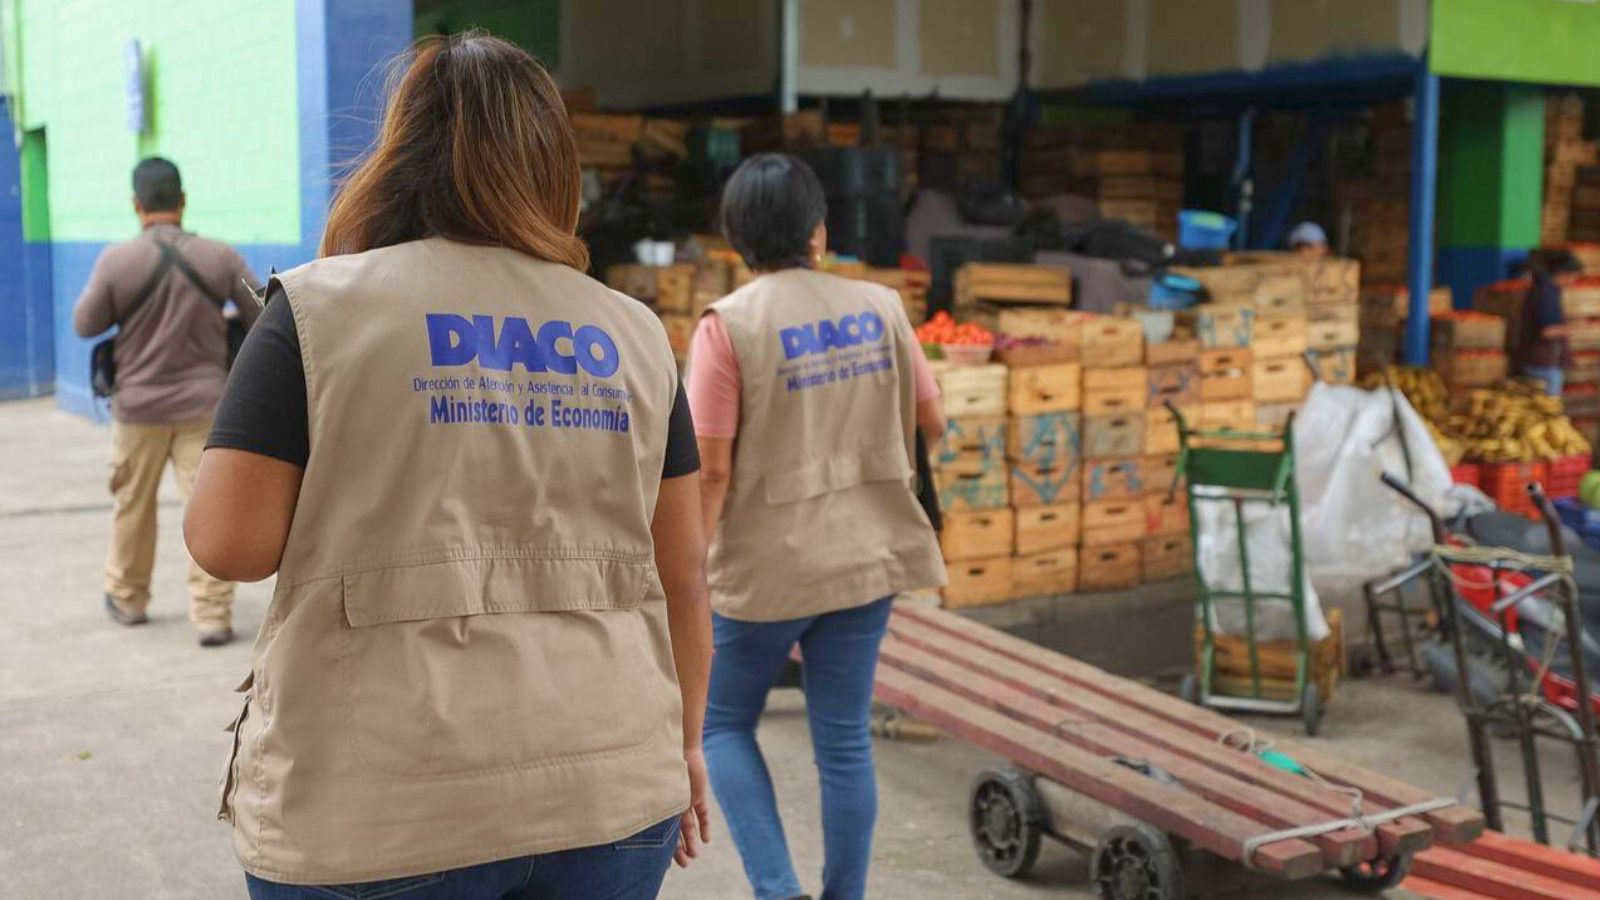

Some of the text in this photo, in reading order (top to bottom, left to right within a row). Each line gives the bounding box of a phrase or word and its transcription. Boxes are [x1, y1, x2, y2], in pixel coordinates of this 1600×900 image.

[426, 313, 619, 378] DIACO
[779, 311, 884, 360] DIACO
[413, 376, 459, 391] Dirección
[464, 376, 475, 389] de
[581, 384, 589, 396] al
[430, 395, 629, 432] Ministerio de Economía
